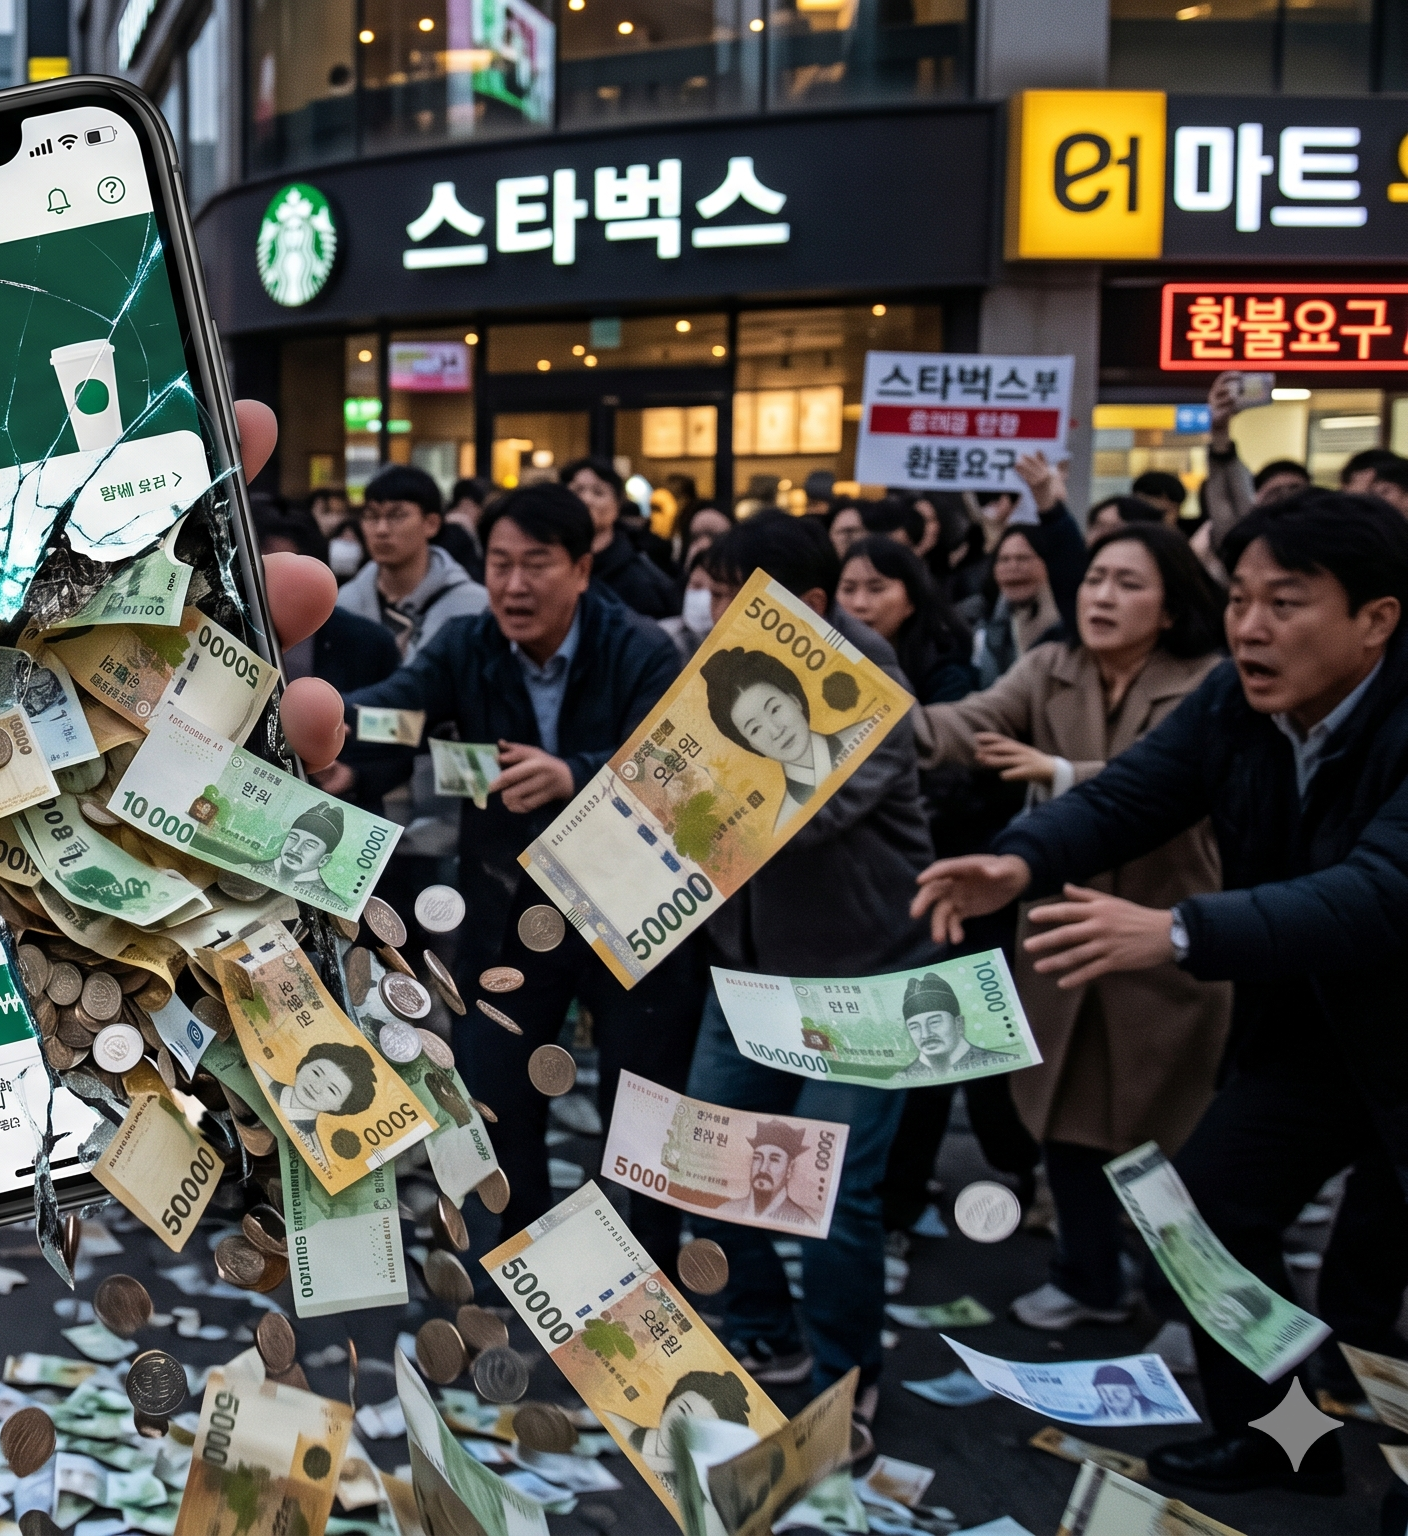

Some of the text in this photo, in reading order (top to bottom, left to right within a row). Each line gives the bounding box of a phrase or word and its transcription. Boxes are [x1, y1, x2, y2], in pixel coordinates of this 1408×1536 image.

[402, 156, 791, 269] 스타벅스
[1173, 122, 1368, 232] 마트
[1186, 296, 1392, 360] 환불요구
[744, 596, 827, 672] 50000
[625, 872, 714, 961] 50000
[161, 1146, 216, 1236] 50000
[500, 1256, 575, 1345] 50000
